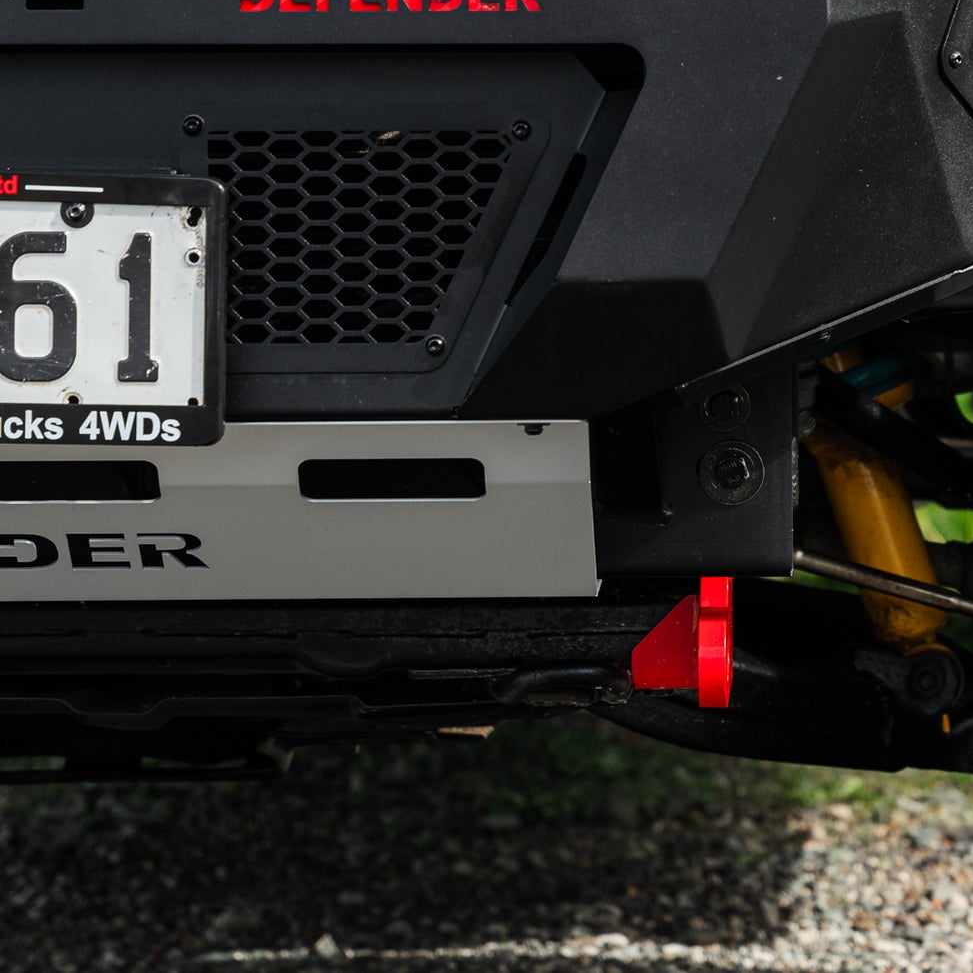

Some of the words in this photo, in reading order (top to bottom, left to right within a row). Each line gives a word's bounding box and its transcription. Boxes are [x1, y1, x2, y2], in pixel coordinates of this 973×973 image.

[0, 230, 160, 382] 61
[0, 409, 64, 440] cks
[79, 410, 181, 441] 4WDs
[0, 533, 210, 570] DER
